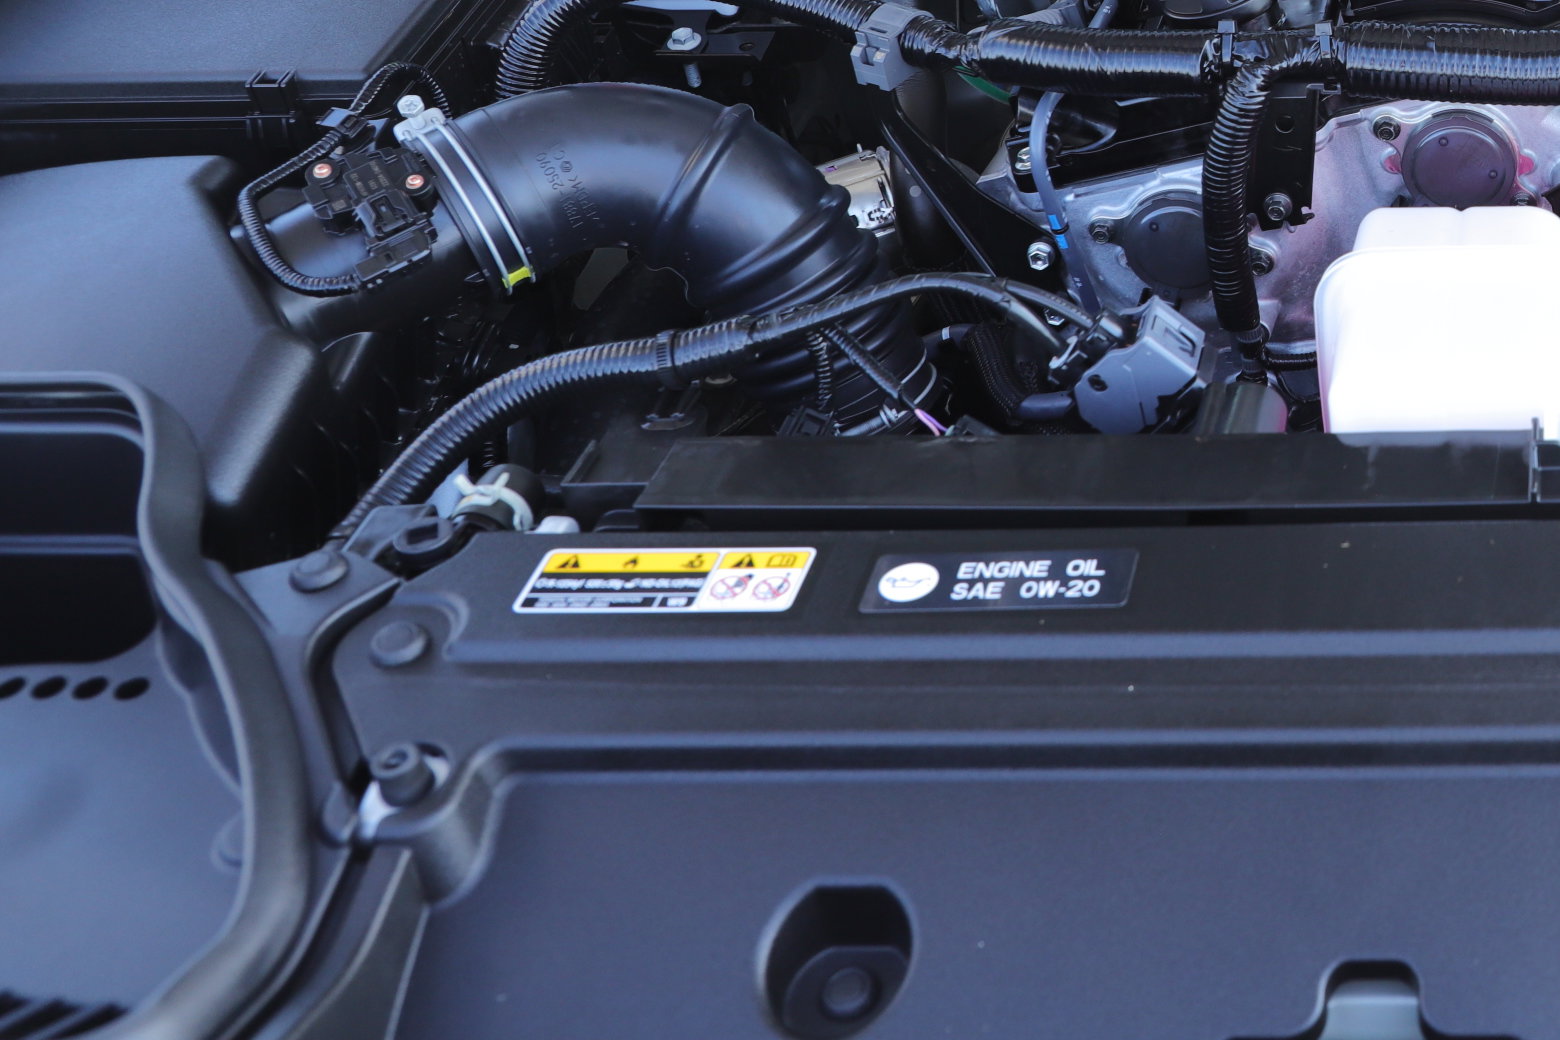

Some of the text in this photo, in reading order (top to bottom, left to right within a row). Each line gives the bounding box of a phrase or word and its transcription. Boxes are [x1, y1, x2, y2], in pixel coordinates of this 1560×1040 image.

[956, 558, 1106, 580] ENGINE OIL
[950, 579, 1102, 600] SAE 0W-20
